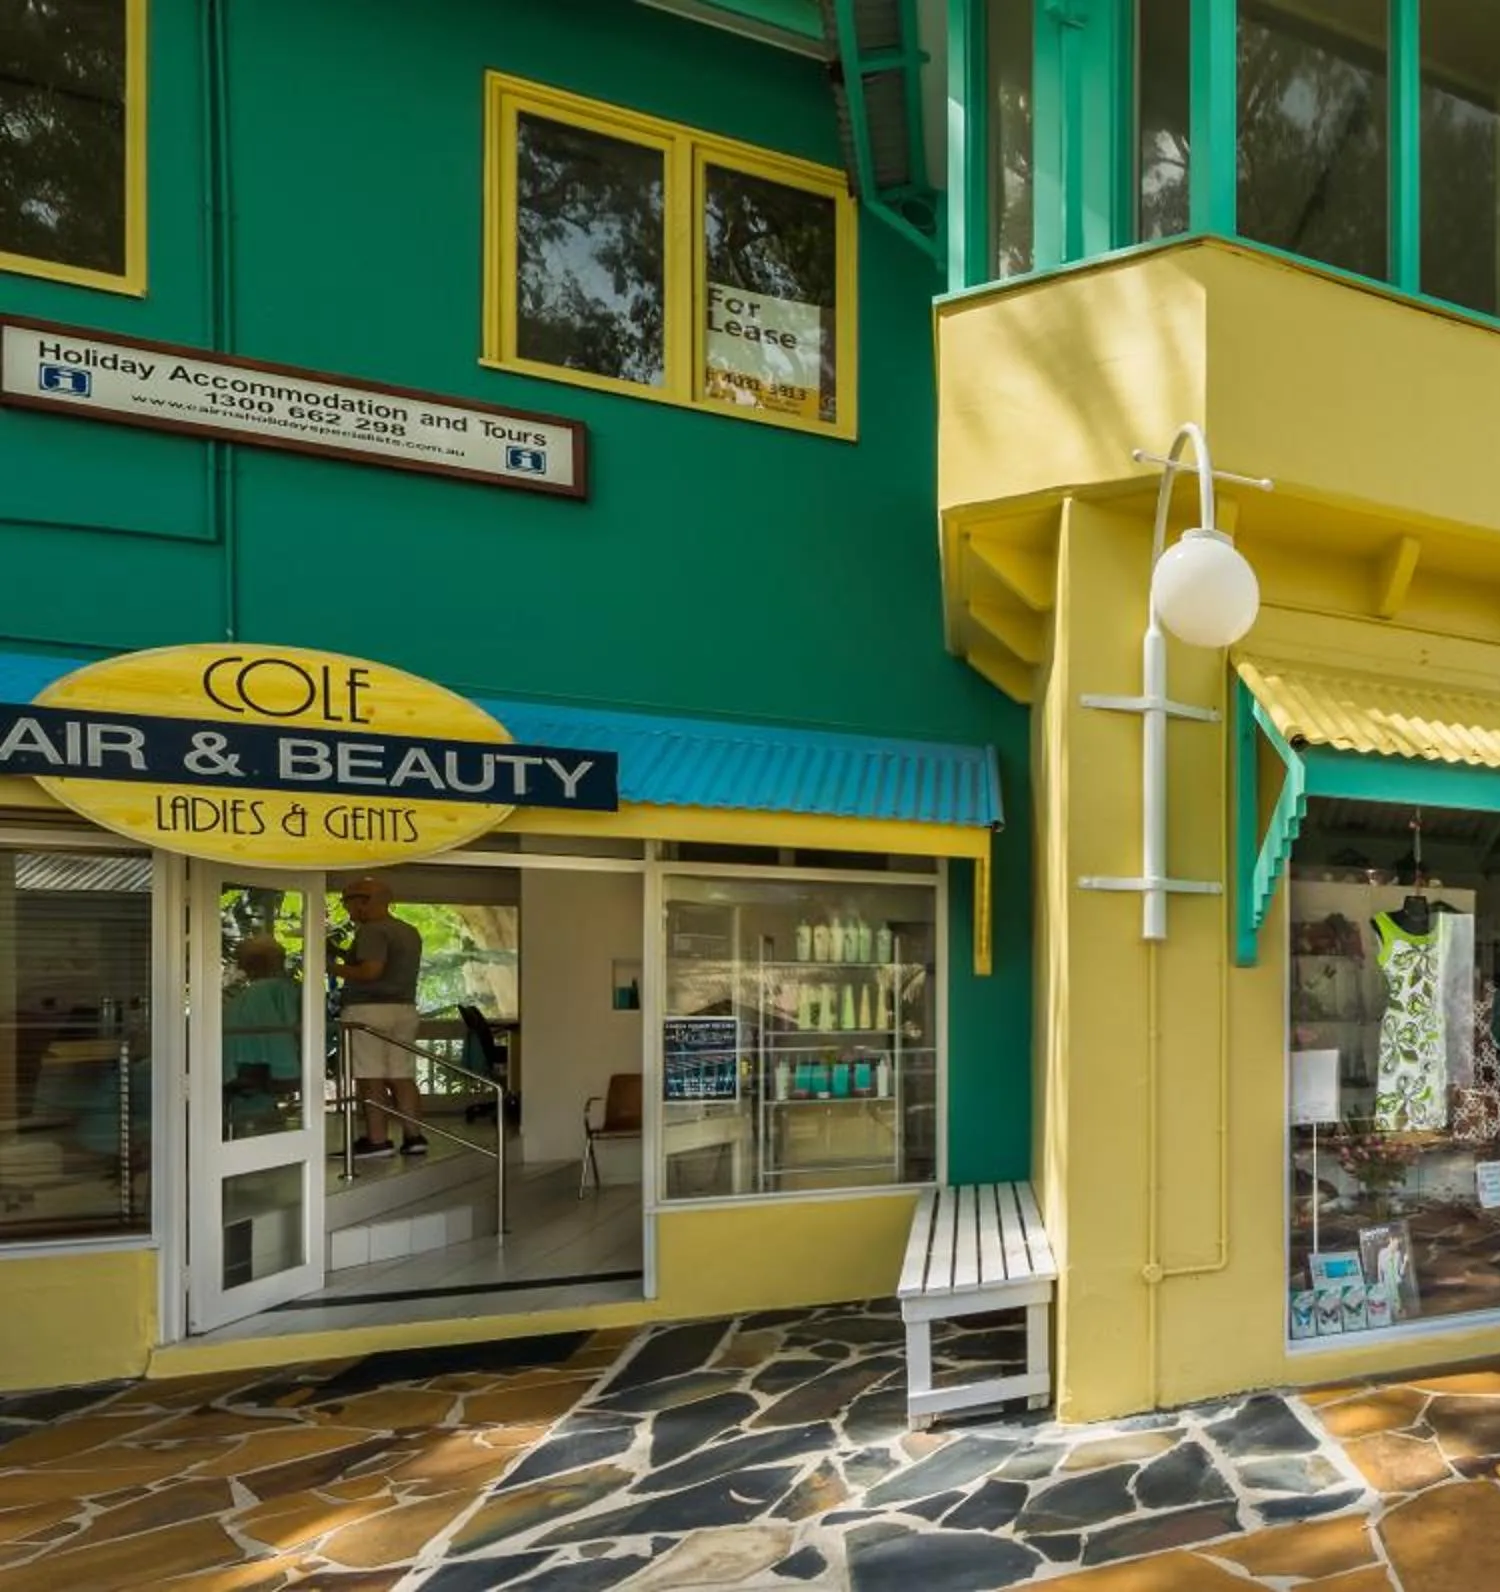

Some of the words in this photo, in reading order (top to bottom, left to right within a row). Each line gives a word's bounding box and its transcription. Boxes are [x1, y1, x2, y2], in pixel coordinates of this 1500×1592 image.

[708, 287, 761, 318] For
[708, 311, 798, 349] Lease
[38, 341, 156, 380] Holiday
[169, 364, 408, 422] Accommodation
[420, 408, 468, 433] and
[480, 420, 547, 447] Tours
[205, 392, 276, 415] 1300
[289, 405, 342, 426] 662
[356, 418, 407, 438] 298
[203, 656, 370, 724] COLE
[0, 717, 148, 770] AIR
[183, 731, 246, 777] &
[278, 737, 594, 799] BEAUTY
[156, 795, 266, 836] LADIES
[281, 803, 308, 837] &
[324, 805, 419, 843] GENTS
